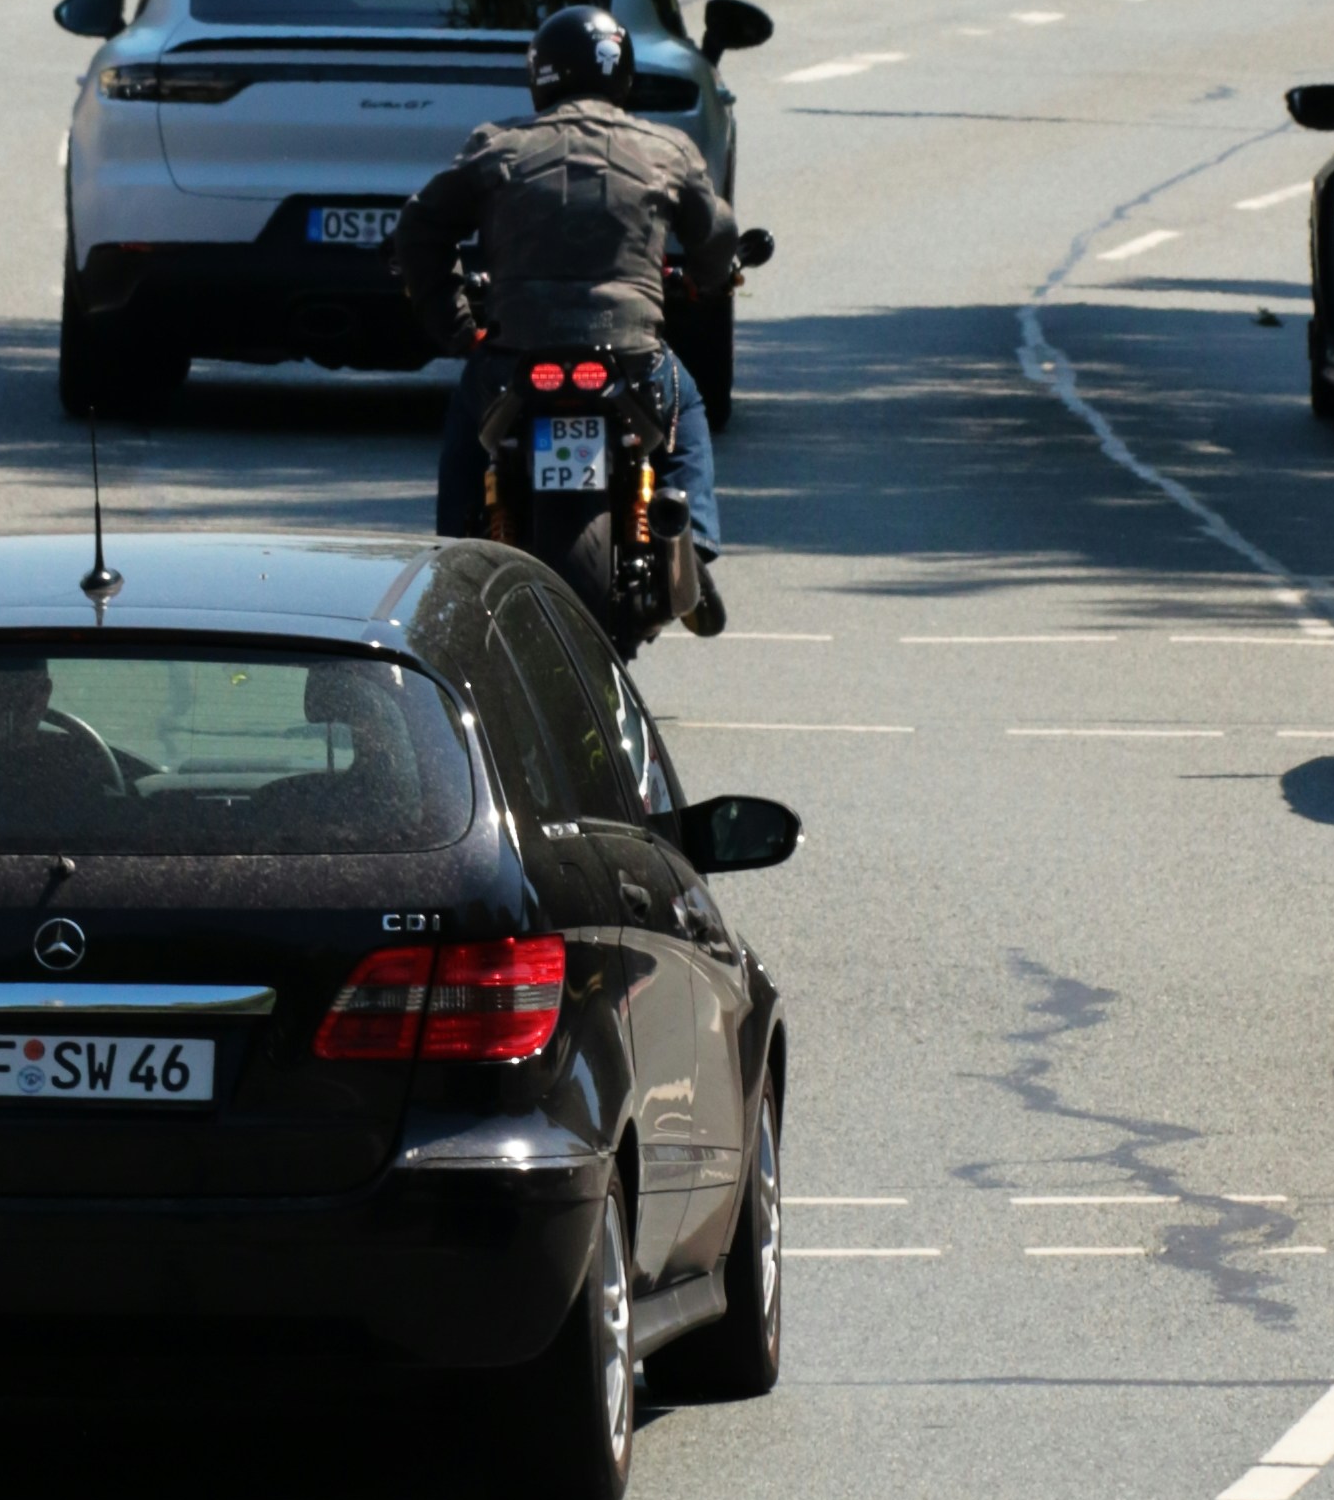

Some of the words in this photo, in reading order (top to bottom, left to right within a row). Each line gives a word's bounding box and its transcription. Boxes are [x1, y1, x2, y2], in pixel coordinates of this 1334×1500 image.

[324, 211, 360, 239] OS
[553, 419, 600, 440] BSB
[542, 466, 573, 488] FP
[582, 466, 597, 487] 2
[382, 913, 441, 931] CDI
[51, 1041, 117, 1091] SW
[128, 1044, 190, 1093] 46
